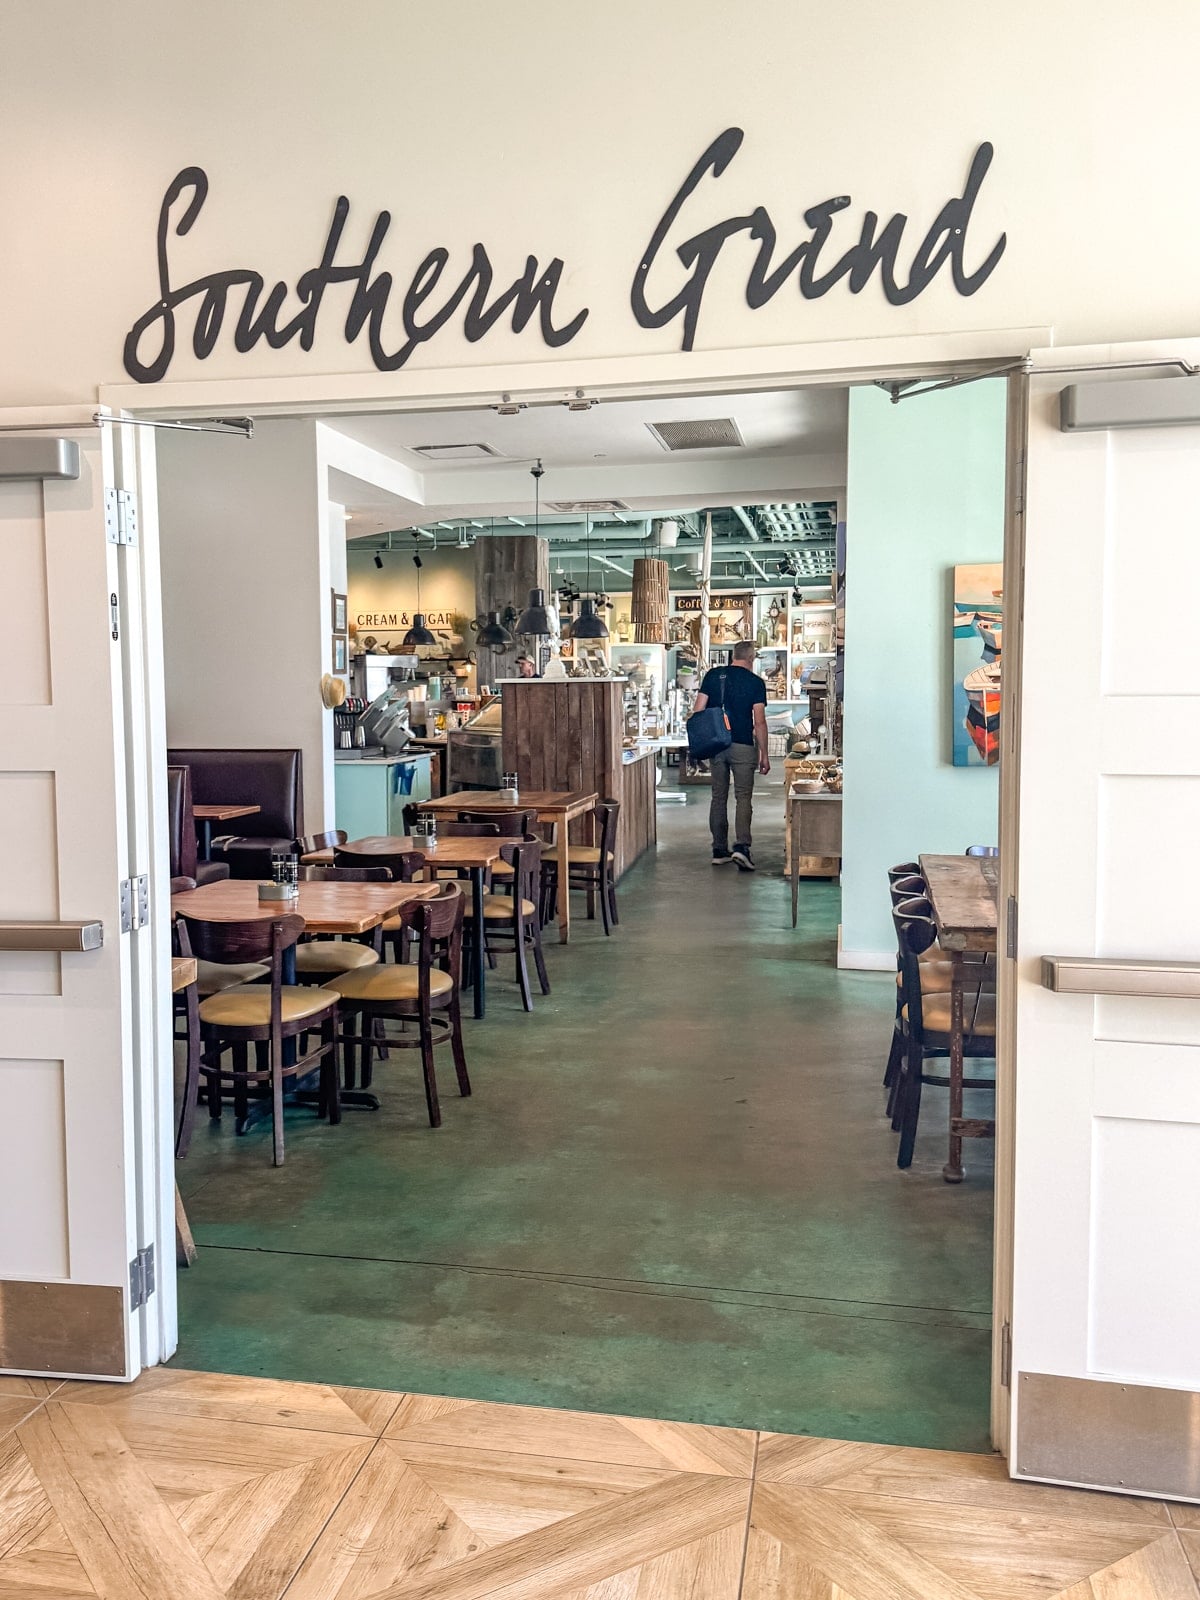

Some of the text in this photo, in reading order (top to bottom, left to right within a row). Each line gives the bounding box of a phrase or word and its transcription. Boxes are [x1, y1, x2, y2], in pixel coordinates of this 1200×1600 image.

[123, 128, 1006, 383] Southern Grind
[678, 598, 744, 609] Coff & Tea
[357, 612, 452, 626] CREAM & GAR
